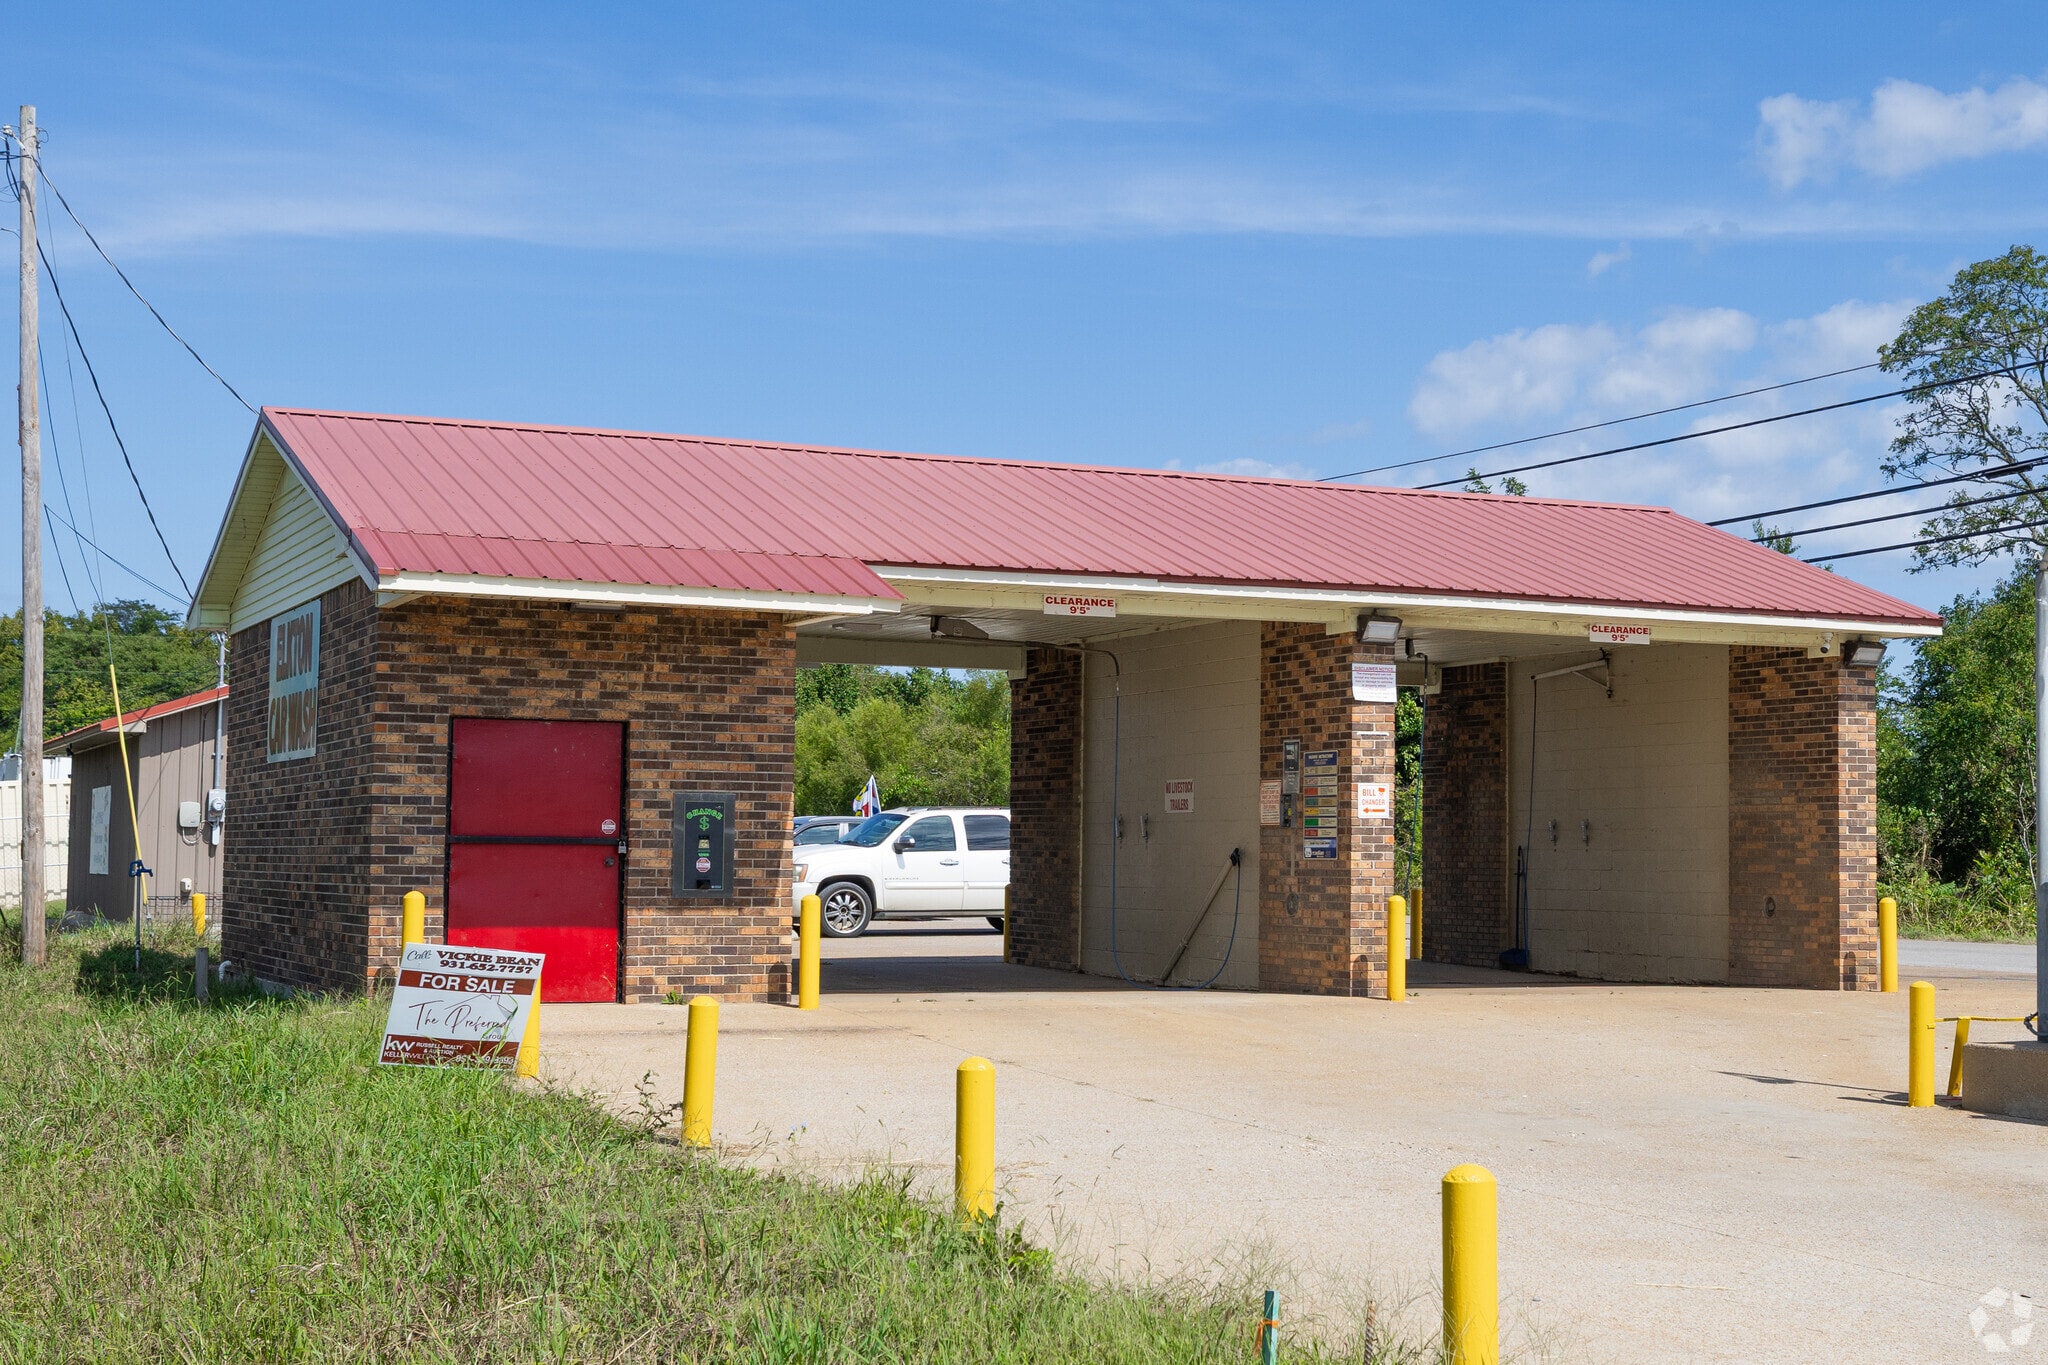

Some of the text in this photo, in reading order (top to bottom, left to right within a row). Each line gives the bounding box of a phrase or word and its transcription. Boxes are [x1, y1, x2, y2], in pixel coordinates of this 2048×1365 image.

[1045, 596, 1115, 607] CLEARANCE
[1591, 625, 1649, 634] CLEARANCE
[276, 613, 313, 682] ELKTON
[269, 687, 317, 756] CAR WASH
[1171, 781, 1193, 794] LIVESTOCK
[1362, 788, 1376, 796] BILL
[1170, 798, 1189, 811] TRAILERS
[1362, 798, 1385, 806] CHANGER
[686, 808, 723, 820] CHANGE
[436, 950, 493, 964] VICKIE
[495, 955, 542, 967] BEAN
[440, 960, 533, 973] 931-652-7757
[419, 974, 516, 994] FOR SALE
[408, 1000, 443, 1030] The
[415, 1041, 441, 1049] RUSSELL
